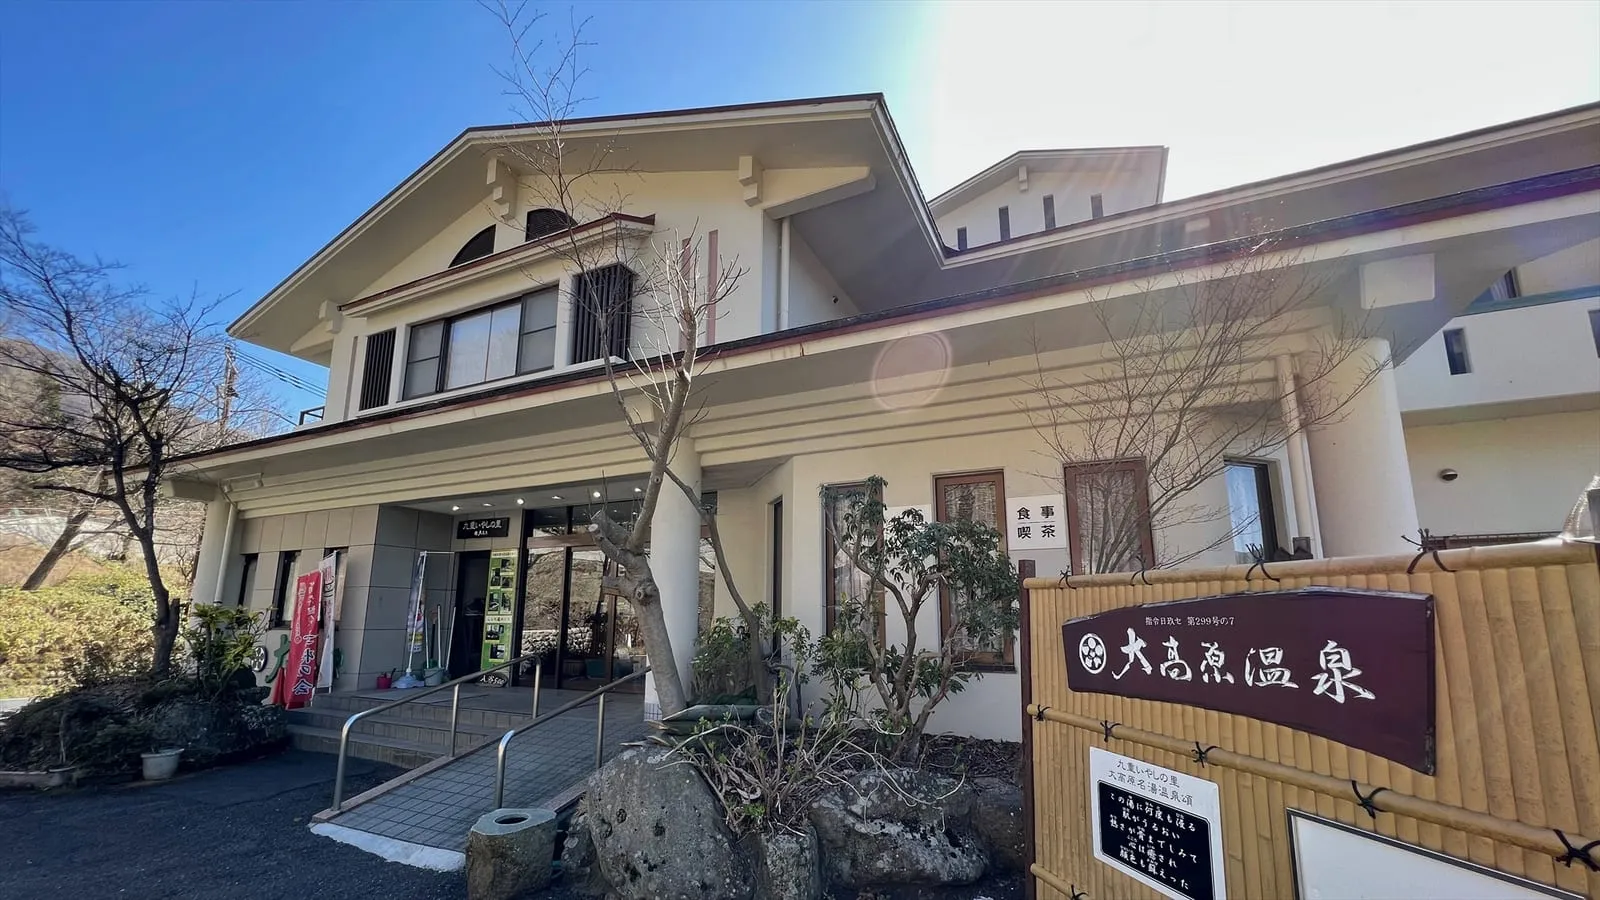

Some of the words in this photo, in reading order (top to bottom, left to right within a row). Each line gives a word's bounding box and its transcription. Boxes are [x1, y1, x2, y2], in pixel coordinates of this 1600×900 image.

[1016, 505, 1055, 520] 食事
[1017, 525, 1056, 539] 喫茶
[1187, 616, 1235, 626] 第299号の7
[1111, 627, 1376, 704] 大高原温泉
[1117, 760, 1181, 789] 九重いやしの里
